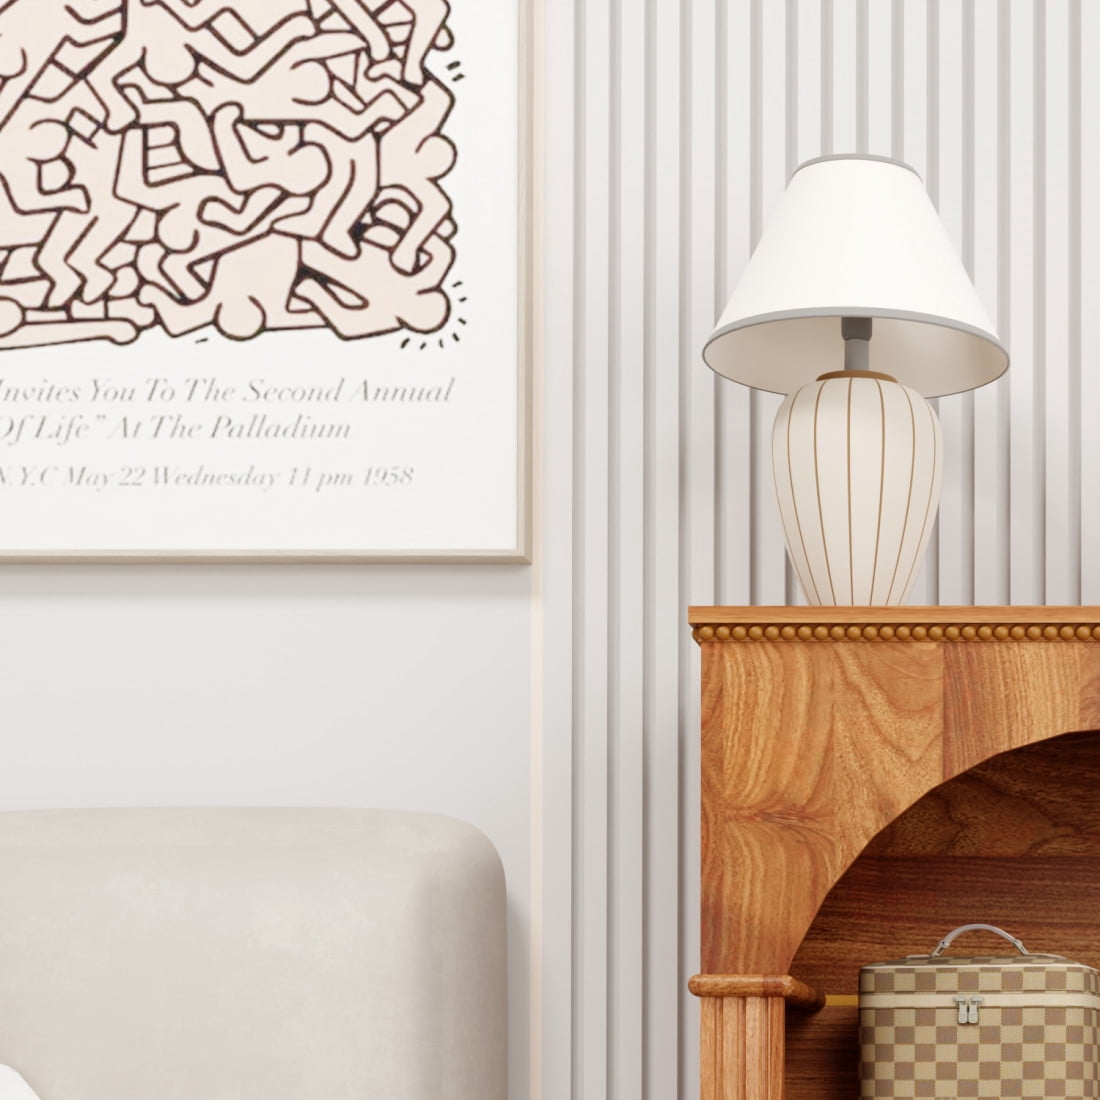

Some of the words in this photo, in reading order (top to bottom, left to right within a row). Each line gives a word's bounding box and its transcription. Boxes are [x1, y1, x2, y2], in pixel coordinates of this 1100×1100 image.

[91, 378, 136, 402] You
[146, 378, 176, 402] To
[185, 377, 236, 402] The
[241, 377, 346, 402] Second
[351, 377, 456, 402] Annual
[107, 414, 142, 439] At
[150, 414, 202, 439] The
[210, 413, 352, 439] Palladium
[66, 466, 114, 493] May
[118, 467, 147, 487] 22
[153, 465, 280, 492] Wednesday
[289, 466, 313, 487] 11
[315, 473, 354, 493] pm
[363, 466, 415, 487] 1958
